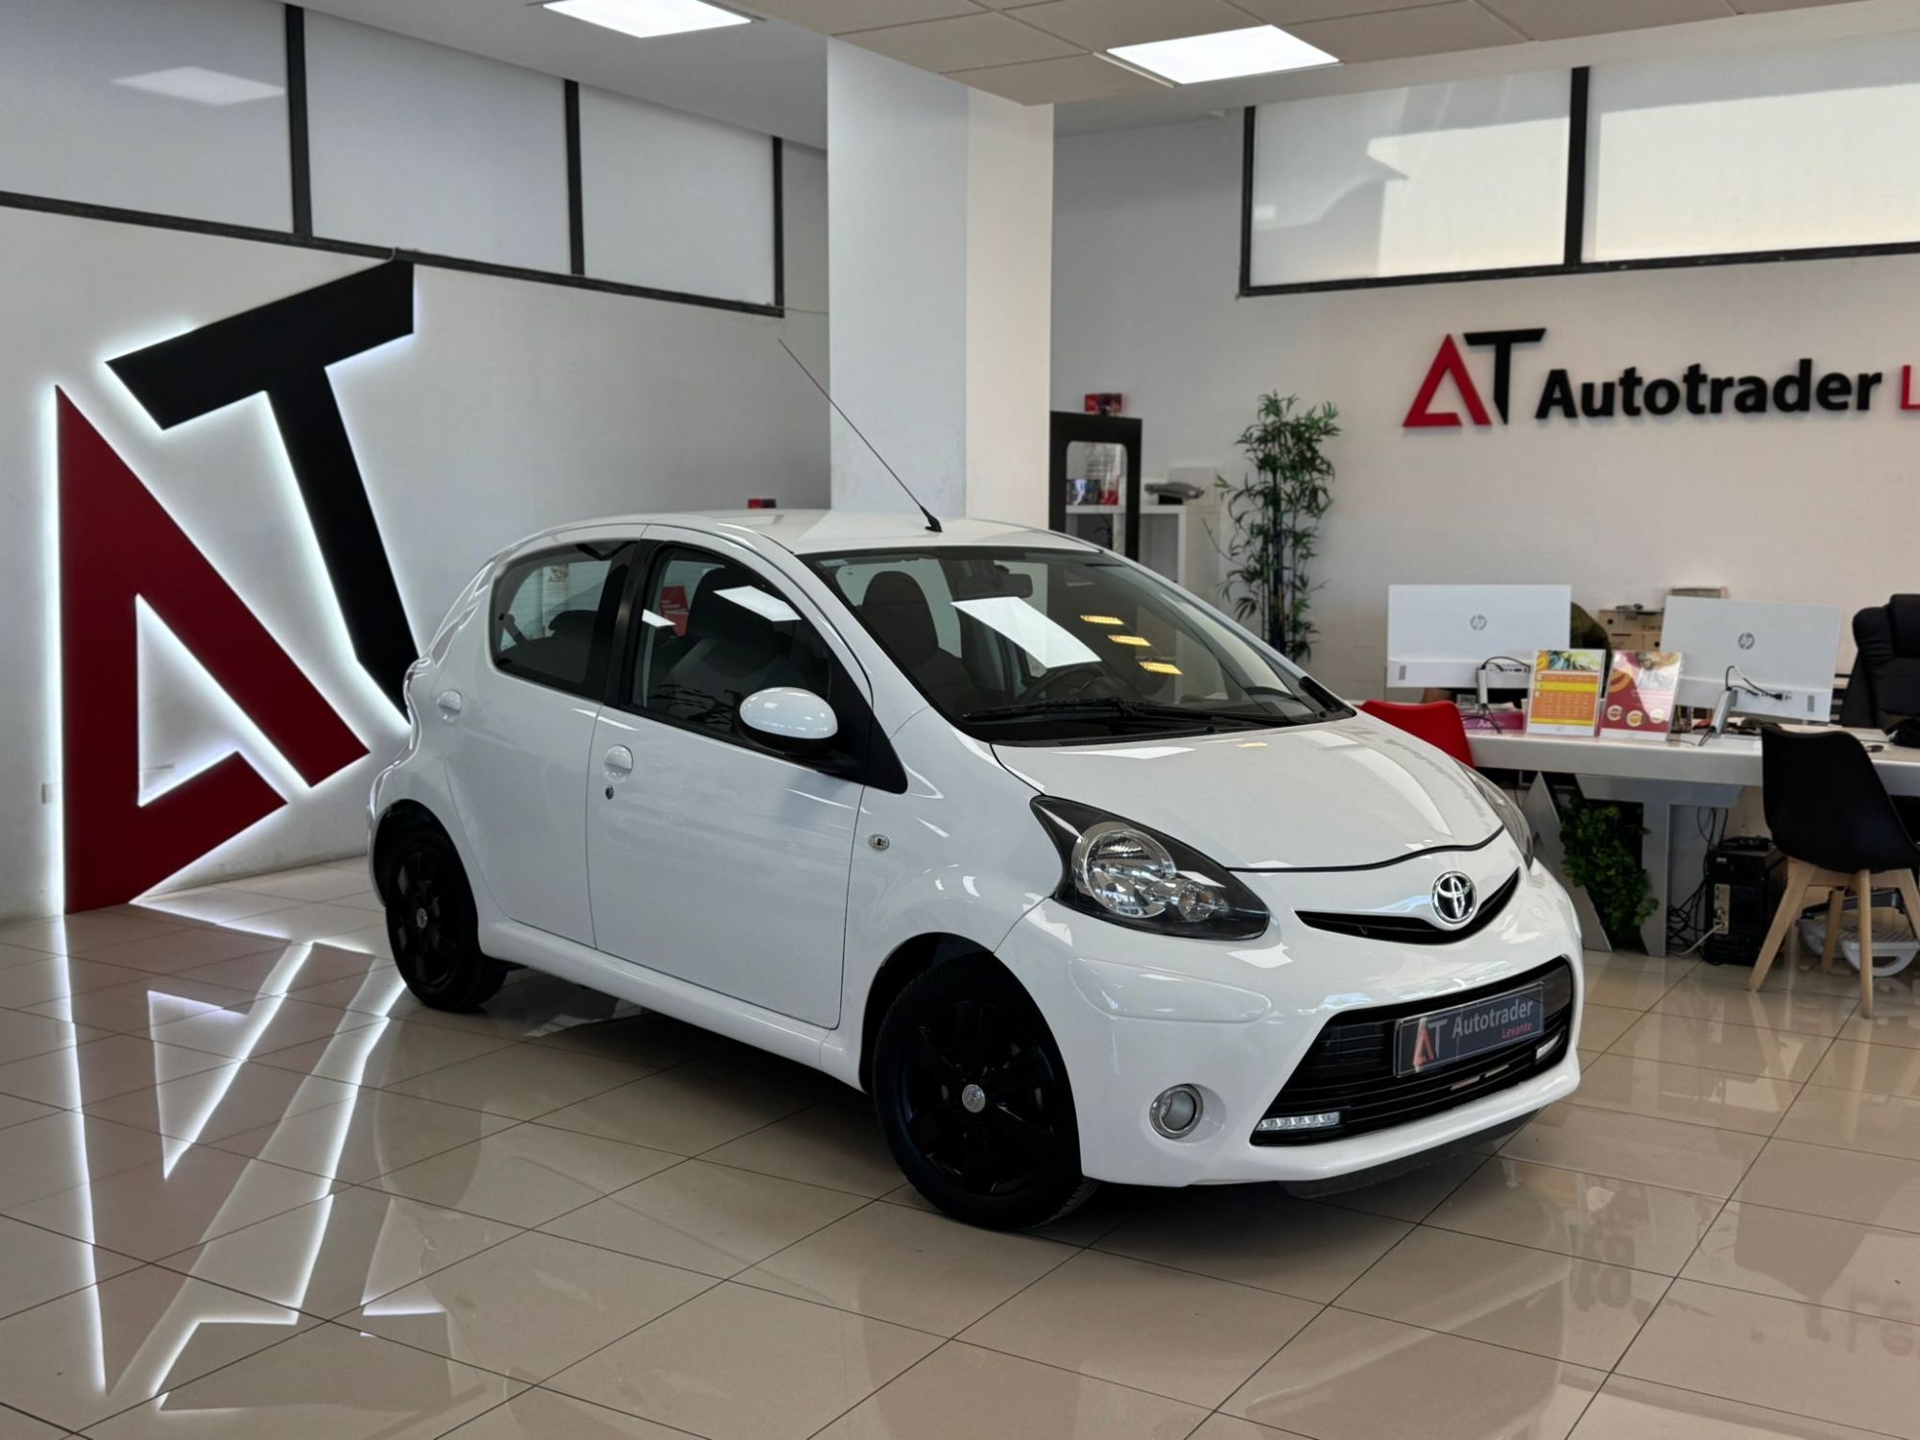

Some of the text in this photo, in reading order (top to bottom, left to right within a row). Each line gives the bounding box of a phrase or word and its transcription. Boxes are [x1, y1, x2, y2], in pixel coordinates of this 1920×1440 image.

[1402, 327, 1547, 427] AT
[1535, 358, 1882, 419] Autotrader
[1453, 999, 1533, 1038] Autotrader
[1502, 1022, 1533, 1039] Levante
